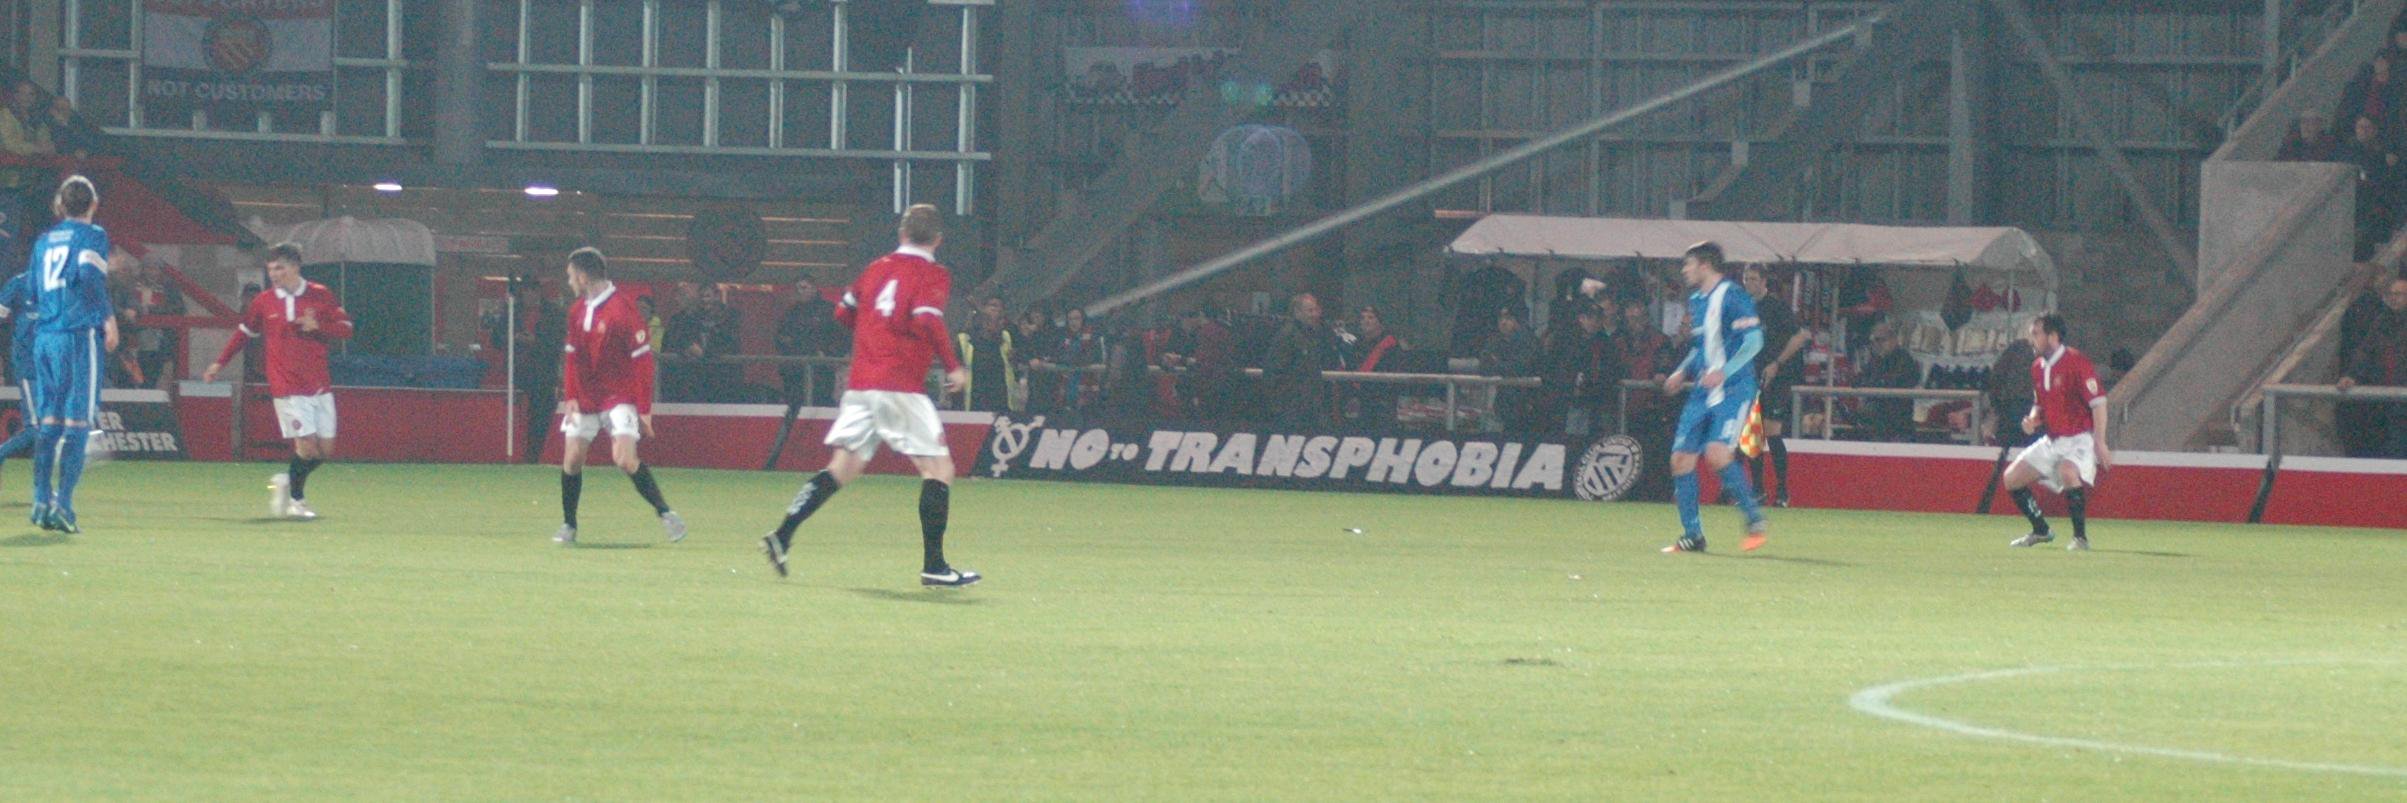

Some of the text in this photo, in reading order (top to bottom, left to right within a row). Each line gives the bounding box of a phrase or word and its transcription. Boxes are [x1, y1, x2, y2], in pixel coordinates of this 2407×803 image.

[147, 79, 326, 101] NOT CUSTOMERS
[43, 245, 70, 292] 12
[874, 279, 898, 317] 4
[1029, 428, 1110, 470] NO
[1145, 430, 1566, 490] TRANSPHOBIA
